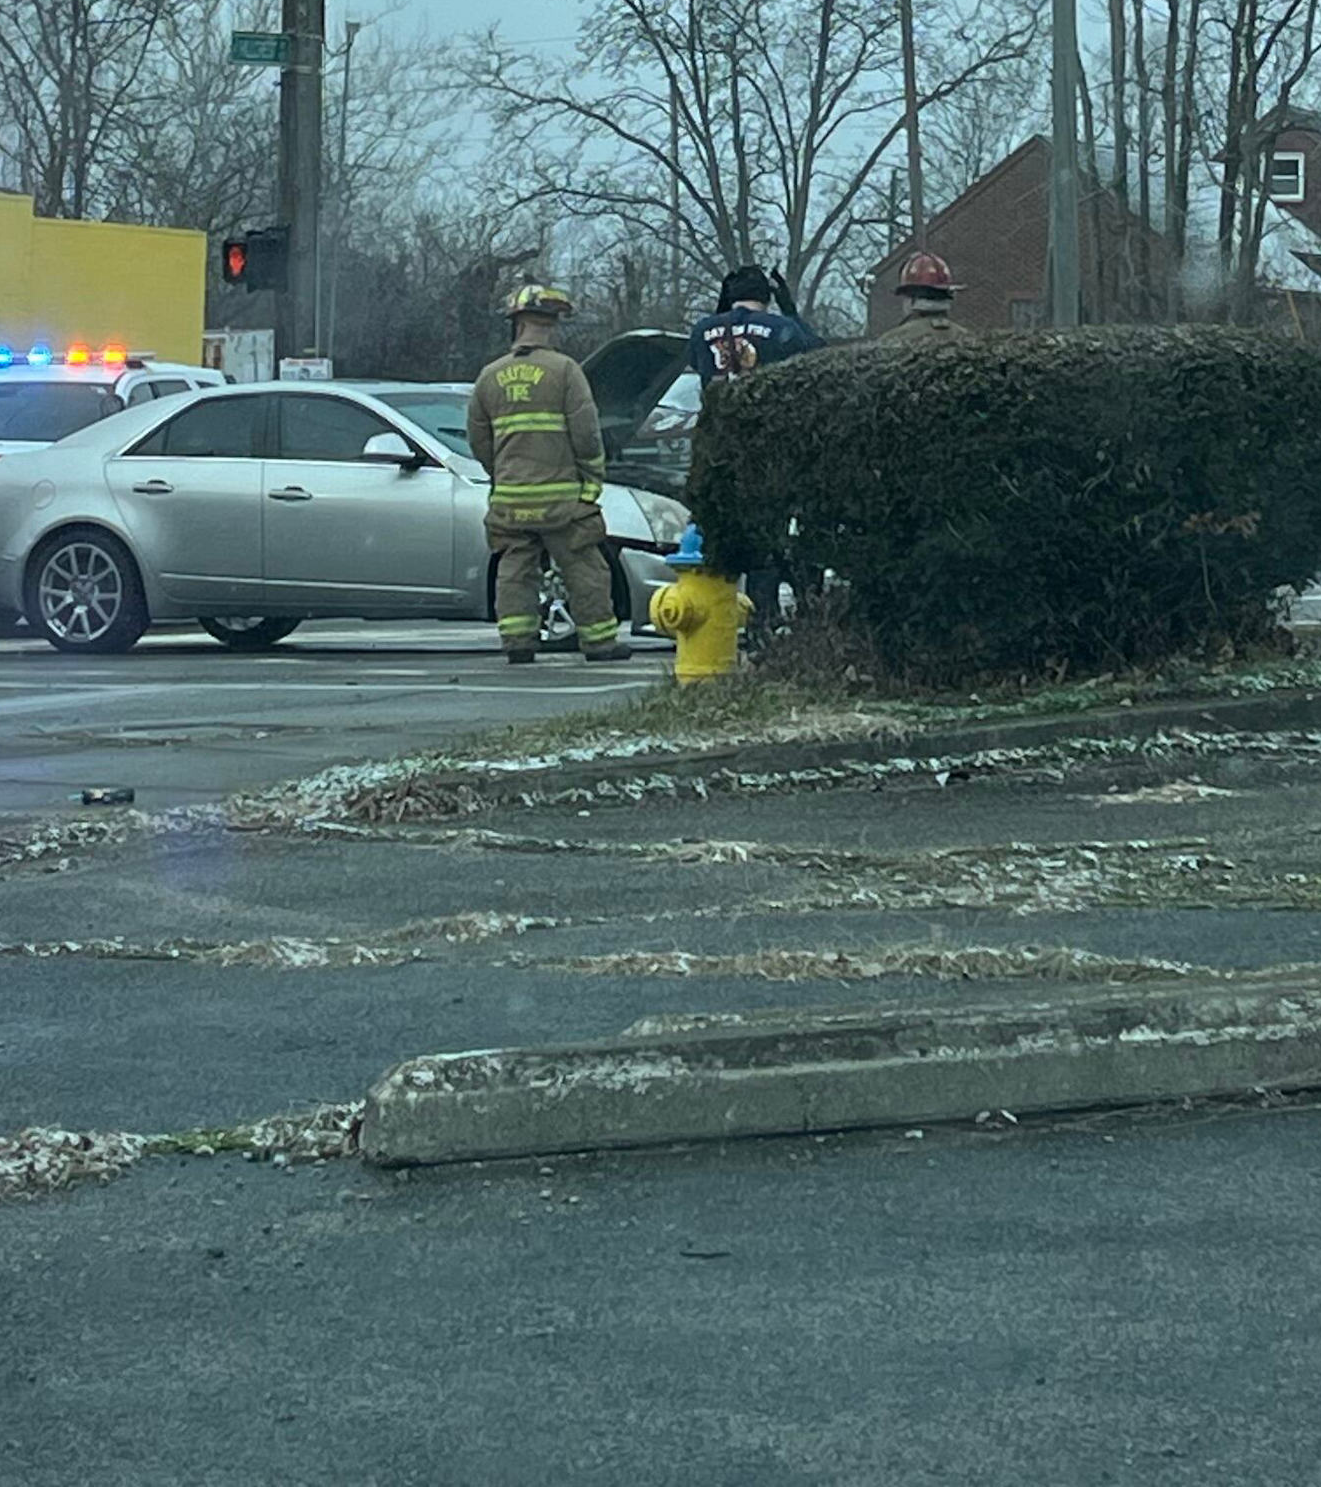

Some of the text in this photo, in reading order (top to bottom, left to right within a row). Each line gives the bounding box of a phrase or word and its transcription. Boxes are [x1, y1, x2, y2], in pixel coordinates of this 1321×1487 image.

[703, 324, 746, 341] DAYON
[496, 363, 545, 387] DAYTON
[506, 384, 532, 402] FIRE
